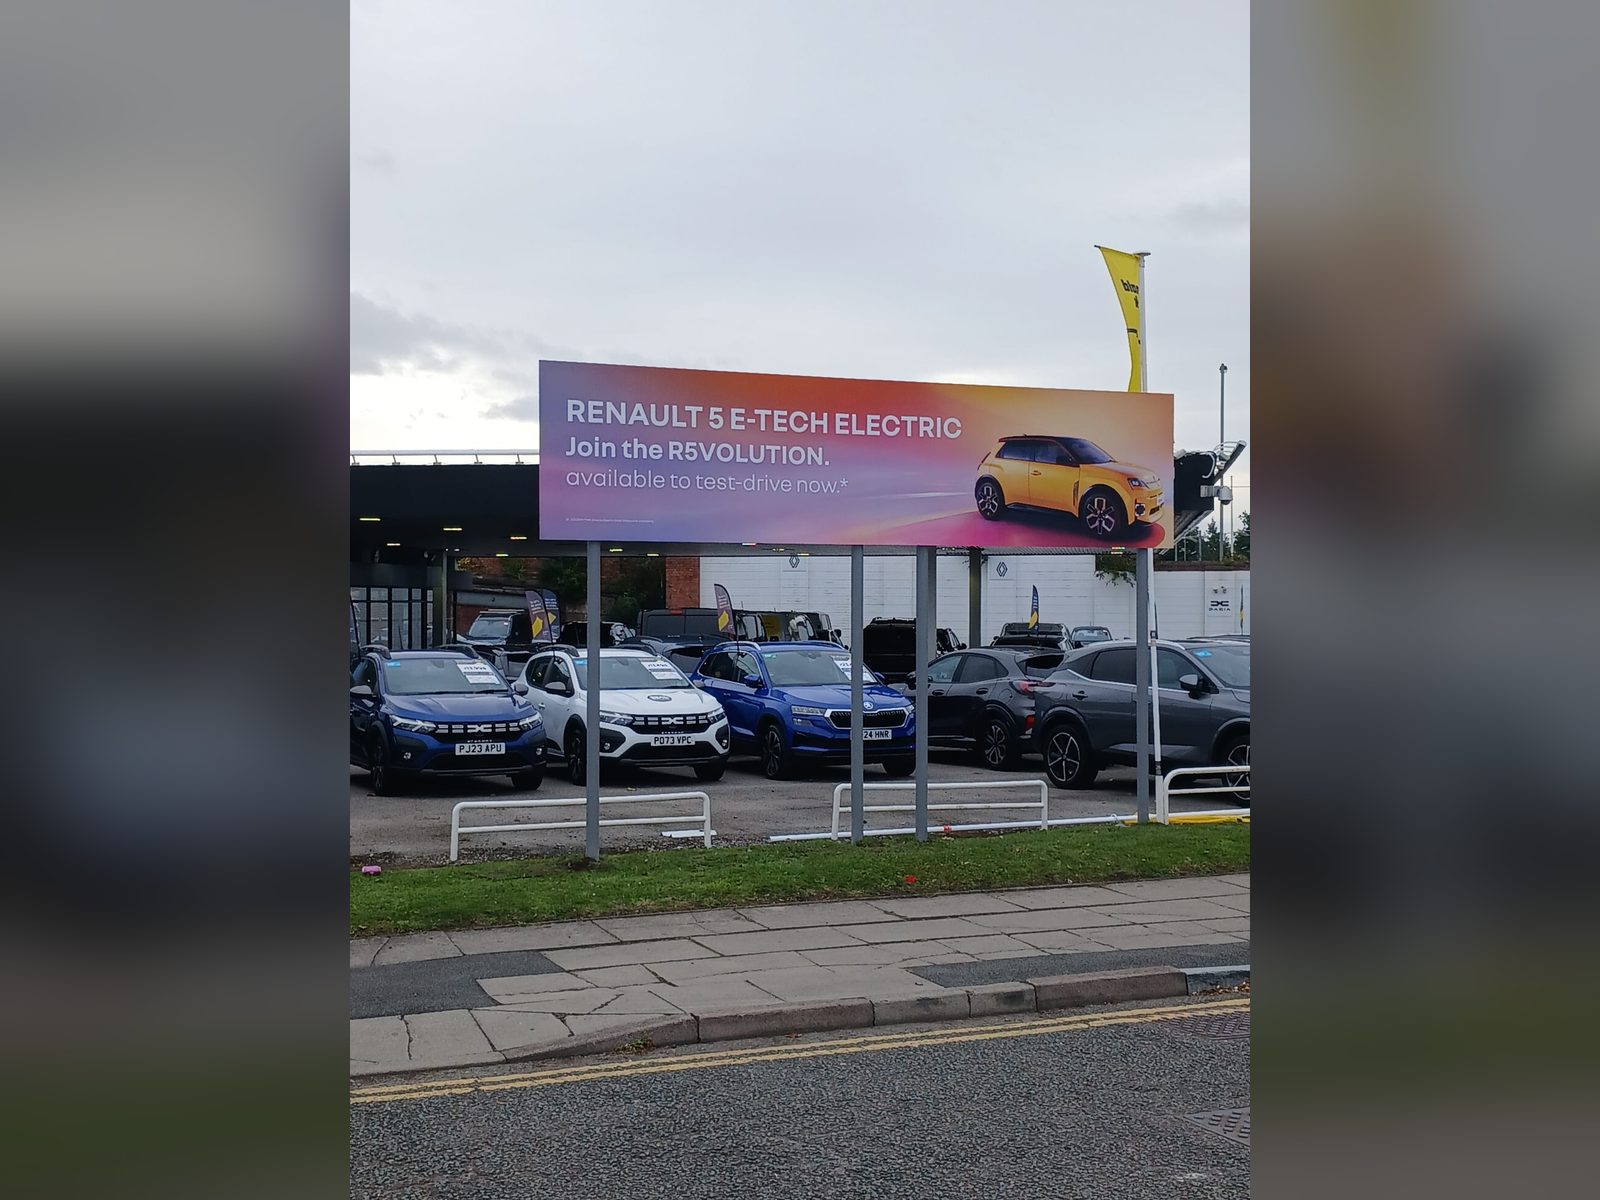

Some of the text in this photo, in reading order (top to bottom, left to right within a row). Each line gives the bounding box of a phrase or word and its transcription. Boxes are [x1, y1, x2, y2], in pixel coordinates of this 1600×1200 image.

[566, 399, 963, 439] RENAULT 5 E-TECH ELECTRIC
[565, 437, 831, 466] Join the R5VOLUTION.
[565, 469, 666, 489] available
[669, 474, 692, 490] to
[695, 474, 793, 493] test-drive
[874, 730, 890, 739] HNR
[459, 743, 502, 754] PJ23 APU
